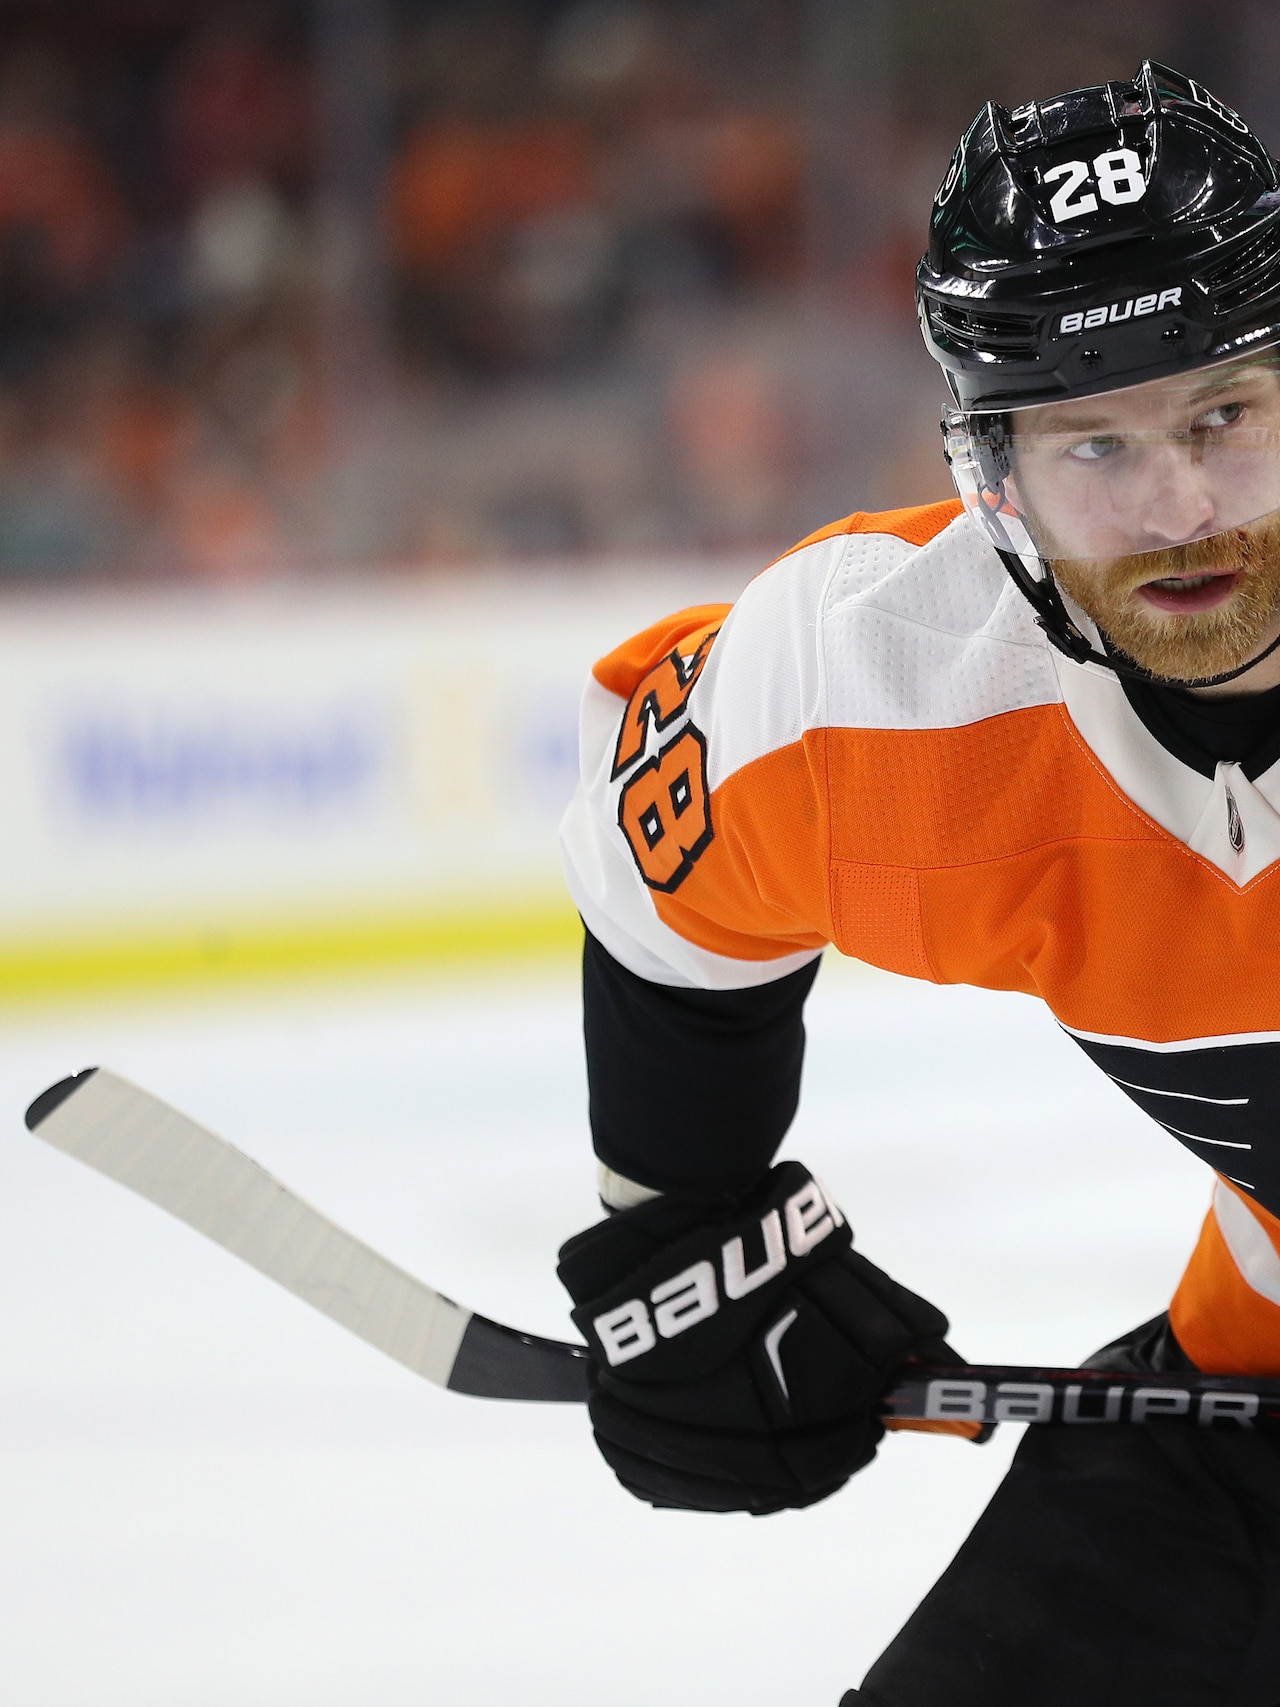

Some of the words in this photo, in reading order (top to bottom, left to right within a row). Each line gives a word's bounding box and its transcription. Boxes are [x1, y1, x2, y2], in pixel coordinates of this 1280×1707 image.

[1043, 148, 1148, 224] 28
[1059, 287, 1183, 334] BAUER
[609, 626, 721, 893] 28
